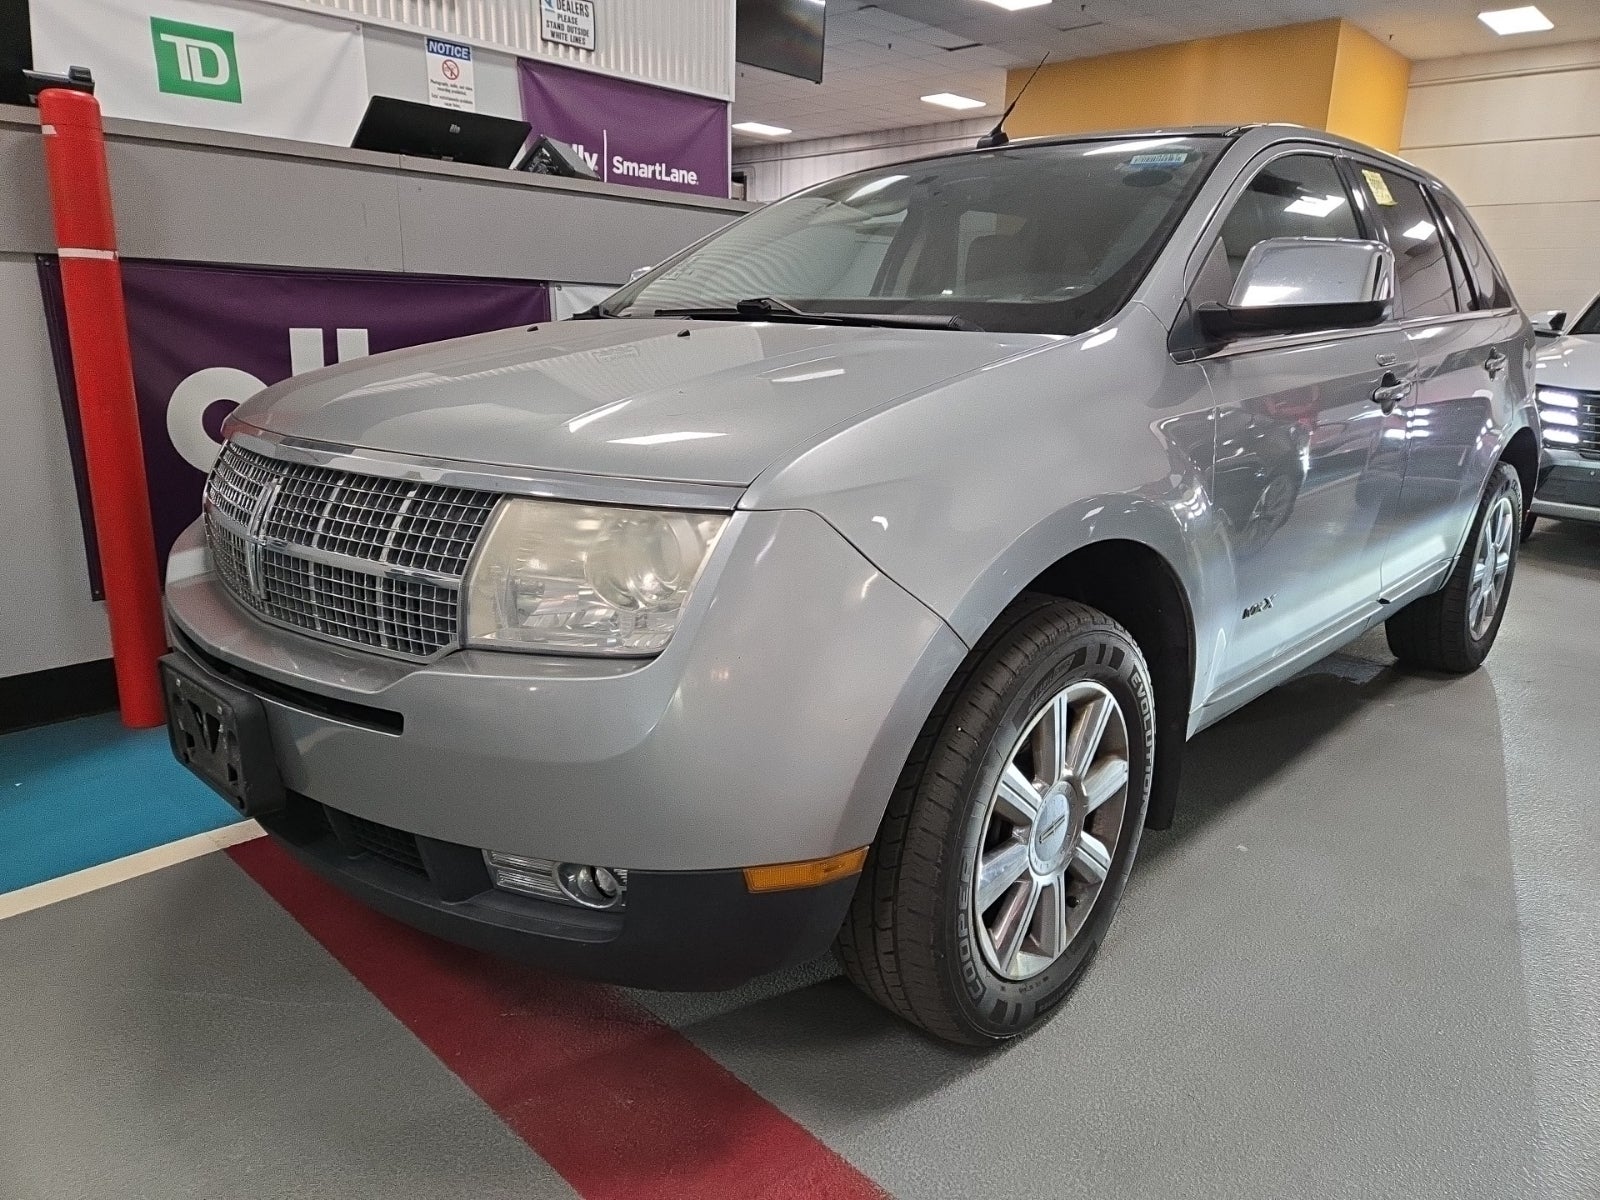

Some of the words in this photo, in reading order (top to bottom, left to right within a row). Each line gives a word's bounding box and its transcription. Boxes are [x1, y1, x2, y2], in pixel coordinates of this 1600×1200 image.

[557, 0, 590, 17] DEALERS
[557, 13, 578, 25] PLEASE
[546, 20, 565, 31] STAND
[567, 25, 589, 37] OUTSIDE
[550, 30, 568, 41] WHITE
[570, 35, 586, 45] LINES
[429, 41, 469, 59] NOTICE
[160, 33, 230, 85] TD
[612, 156, 698, 185] SmartLane
[958, 855, 984, 1000] COOPER
